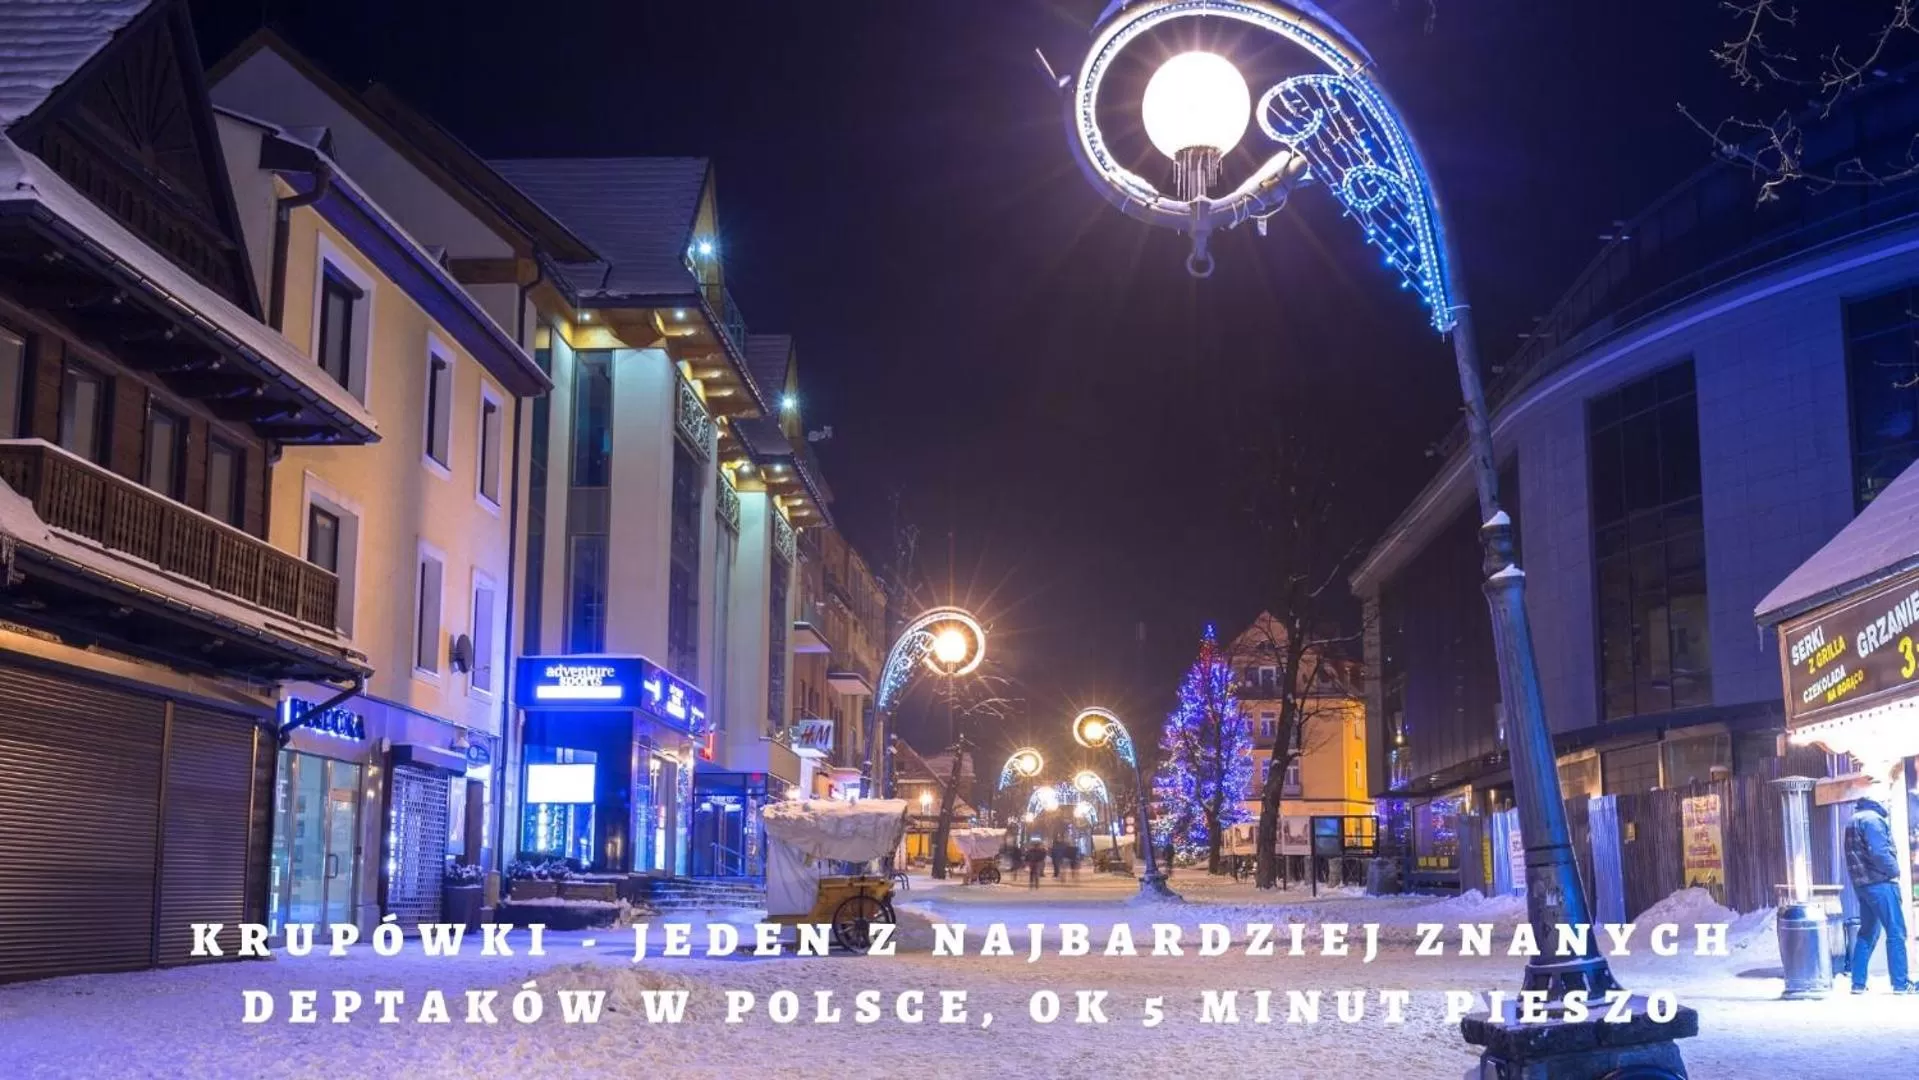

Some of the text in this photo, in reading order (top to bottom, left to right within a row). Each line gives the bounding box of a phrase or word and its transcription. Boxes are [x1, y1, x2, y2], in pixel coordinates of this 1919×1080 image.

[1791, 625, 1825, 666] SERKI
[1808, 635, 1846, 675] Z GRILLA
[546, 664, 615, 677] adventure
[1803, 664, 1846, 704] CZEKOLADA
